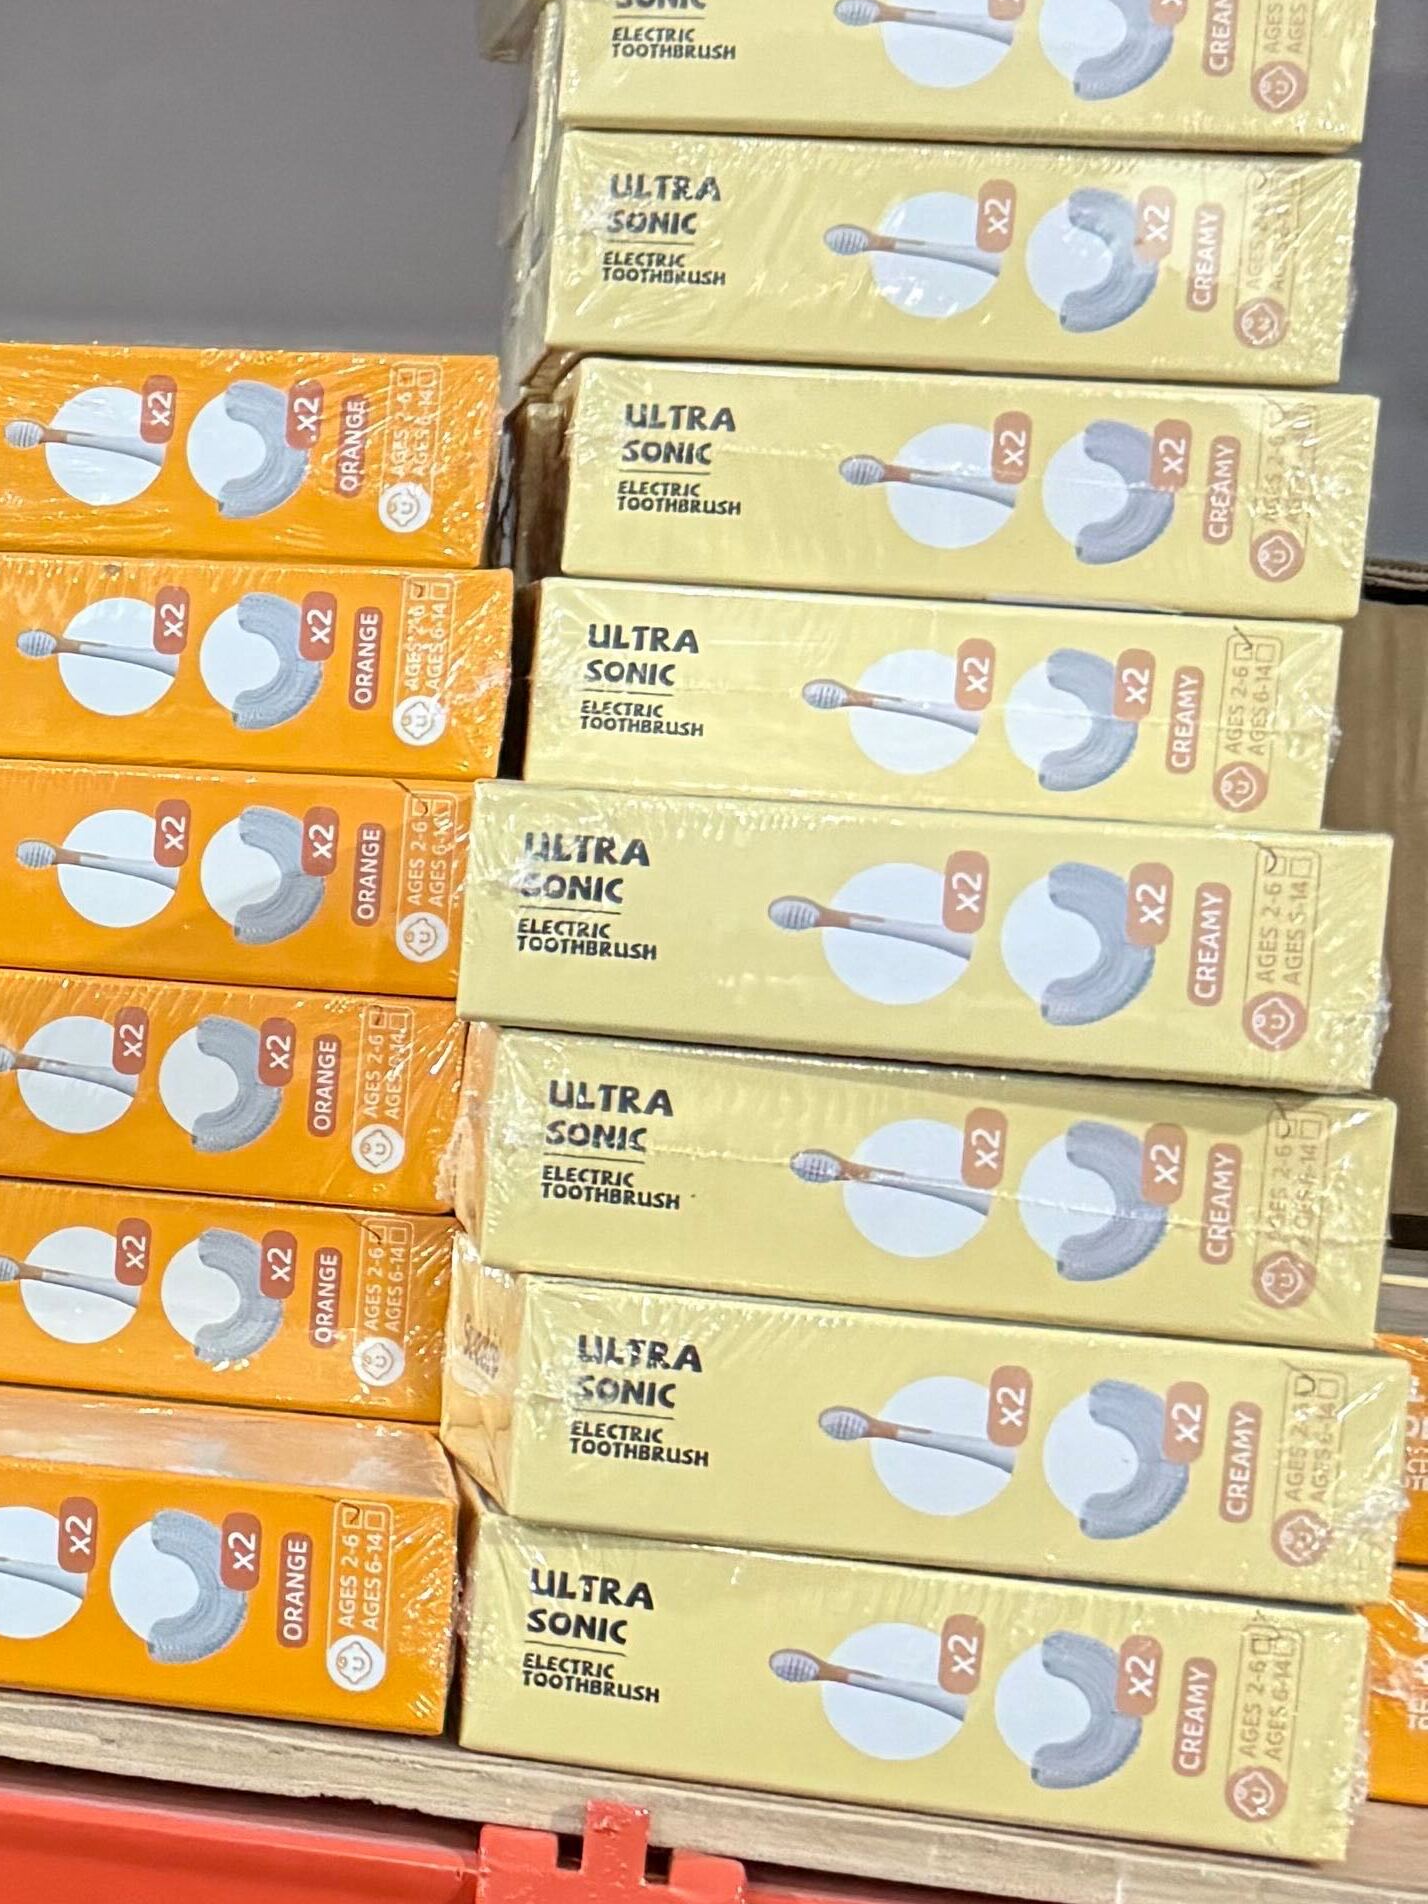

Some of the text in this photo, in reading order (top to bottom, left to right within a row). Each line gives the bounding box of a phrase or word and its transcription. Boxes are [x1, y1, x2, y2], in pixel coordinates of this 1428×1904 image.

[612, 27, 695, 42] ELECTRIC
[612, 44, 736, 59] TOOTHBRUSH
[610, 172, 721, 202] ULTRA
[607, 209, 697, 235] SONIC
[602, 251, 685, 268] ELECTRIC
[1192, 210, 1219, 306] CREAMY
[624, 403, 736, 432] ULTRA
[339, 400, 364, 493] ORANGE
[621, 439, 712, 465] SONIC
[617, 480, 701, 496] ELECTRIC
[1209, 443, 1237, 539] CREAMY
[617, 496, 741, 515] TOOTHBRUSH
[587, 623, 699, 654] ULTRA
[354, 612, 379, 705] ORANGE
[583, 659, 676, 687] SONIC
[580, 700, 664, 718] ELECTRIC
[1172, 674, 1200, 769] CREAMY
[579, 715, 704, 737] TOOTHBRUSH
[356, 827, 381, 921] ORANGE
[517, 917, 611, 940] ELECTRIC
[517, 935, 657, 961] TOOTHBRUSH
[1195, 891, 1224, 999] CREAMY
[313, 1039, 338, 1131] ORANGE
[548, 1079, 674, 1116] ULTRA
[545, 1121, 647, 1152] SONIC
[542, 1165, 634, 1187] ELECTRIC
[541, 1182, 681, 1210] TOOTHBRUSH
[1205, 1151, 1236, 1258] CREAMY
[314, 1253, 338, 1344] ORANGE
[571, 1420, 663, 1444] ELECTRIC
[570, 1437, 709, 1468] TOOTHBRUSH
[1225, 1408, 1255, 1517] CREAMY
[282, 1539, 308, 1642] ORANGE
[337, 1534, 358, 1629] AGES 2-6
[529, 1568, 655, 1610] ULTRA
[361, 1575, 379, 1632] AGES
[526, 1609, 628, 1645] SONIC
[523, 1652, 615, 1678] ELECTRIC
[522, 1671, 660, 1703] TOOTHBRUSH
[1179, 1665, 1210, 1771] CREAMY
